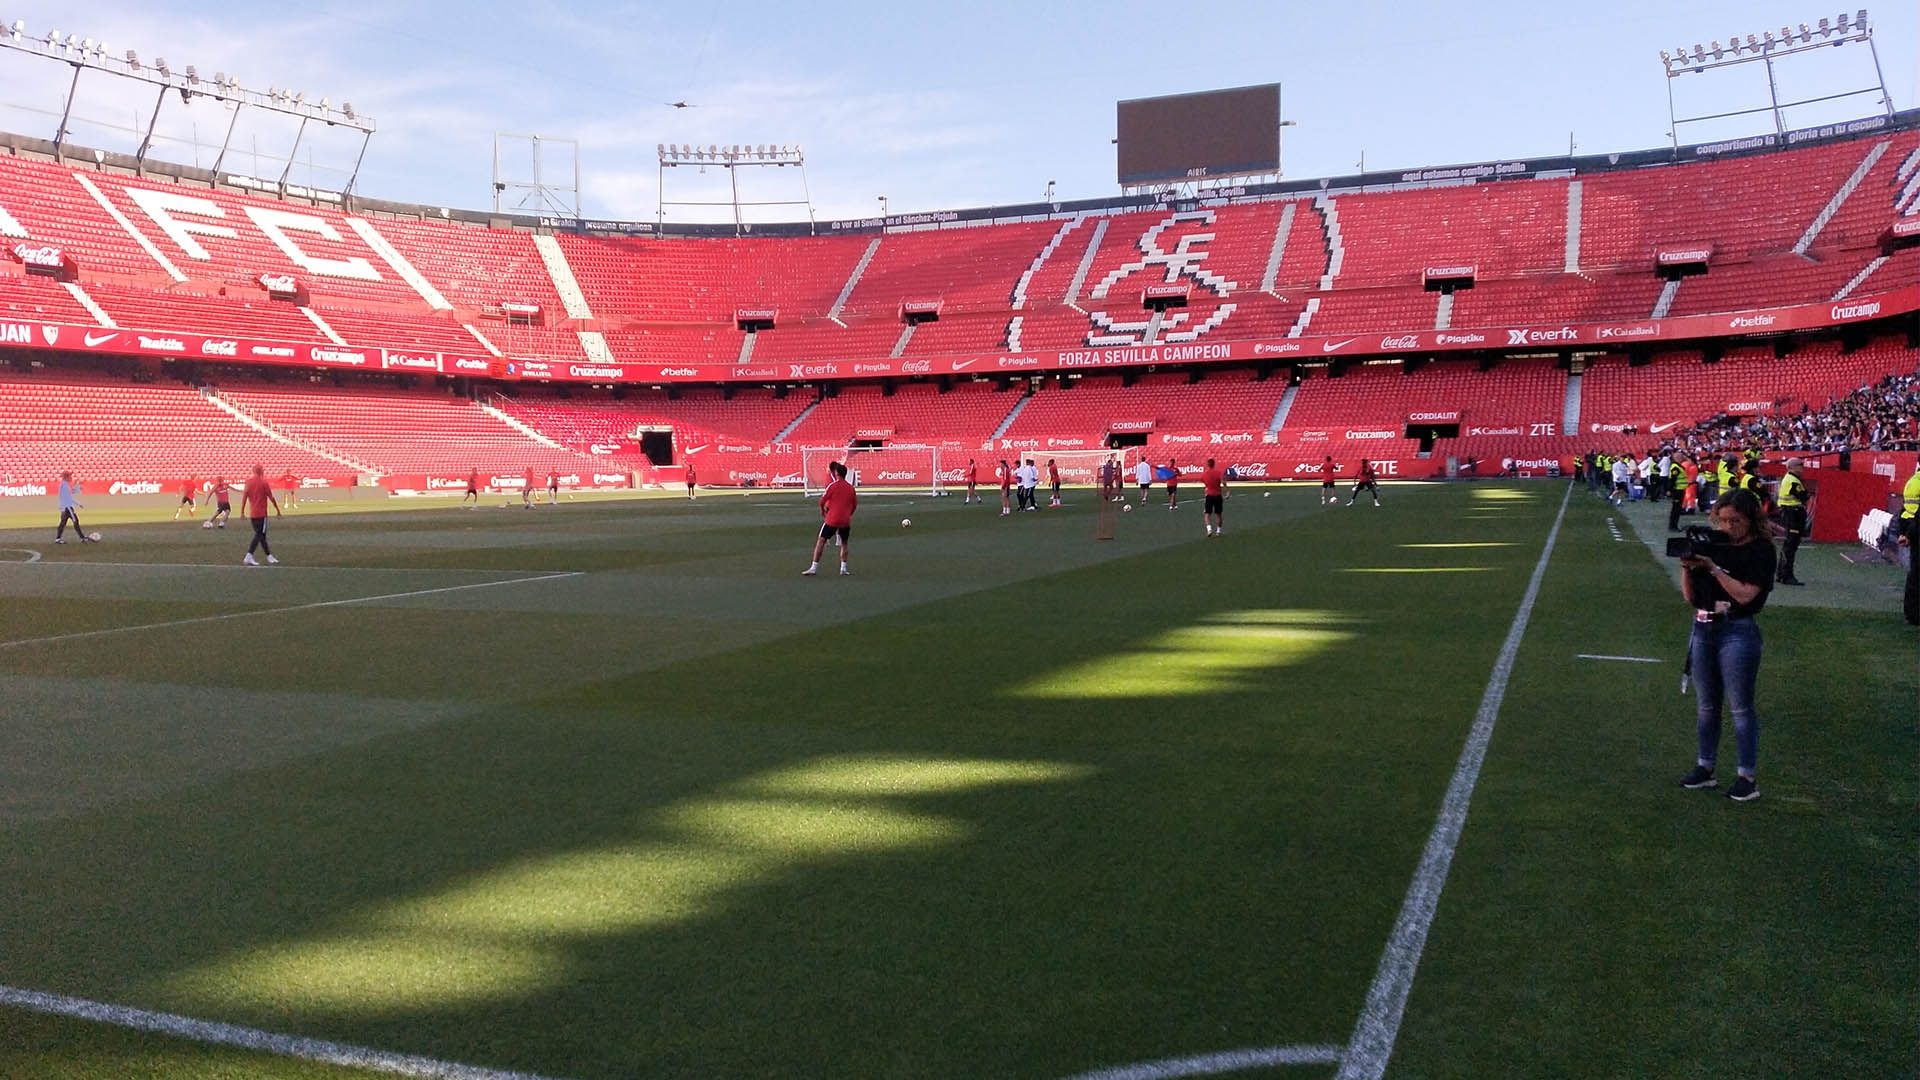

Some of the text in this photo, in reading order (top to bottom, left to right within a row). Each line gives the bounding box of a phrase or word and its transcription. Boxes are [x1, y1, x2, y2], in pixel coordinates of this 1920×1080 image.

[1696, 117, 1886, 155] compartiendo la gloria en tu escudo
[1187, 167, 1207, 177] AIRIS
[1423, 169, 1460, 179] estamos
[1461, 165, 1495, 177] contigo
[1496, 162, 1526, 174] Sevilla
[1219, 186, 1246, 197] Sevilla
[1660, 250, 1710, 261] Cruzcampo
[1427, 266, 1473, 276] Cruzcampo
[1147, 286, 1188, 294] Cruzcampo
[738, 308, 775, 317] Cruzcampo
[1831, 302, 1881, 320] Cruzcampo
[1740, 314, 1776, 328] betfair
[1530, 326, 1578, 341] everfx
[1613, 326, 1655, 337] CaixaBank
[1447, 333, 1485, 344] Playtika
[1265, 343, 1300, 353] Playtika
[1058, 344, 1231, 366] FORZA SEVILLA CAMPEON
[1008, 356, 1038, 366] Playtika
[570, 365, 623, 379] Cruzcampo
[669, 367, 699, 377] betfair
[805, 363, 838, 375] everfx
[1409, 411, 1458, 421] CORDIALITY
[1112, 421, 1153, 430] CORDIALITY
[1530, 423, 1556, 436] ZTE
[1223, 432, 1253, 441] everfx
[1346, 429, 1396, 440] Cruzcampo
[1013, 438, 1039, 447] everfx
[1056, 438, 1084, 446] Playtika
[775, 443, 793, 454] ZTE
[1515, 458, 1558, 470] Playtika
[738, 471, 767, 480] Playtika
[886, 470, 917, 480] betfair
